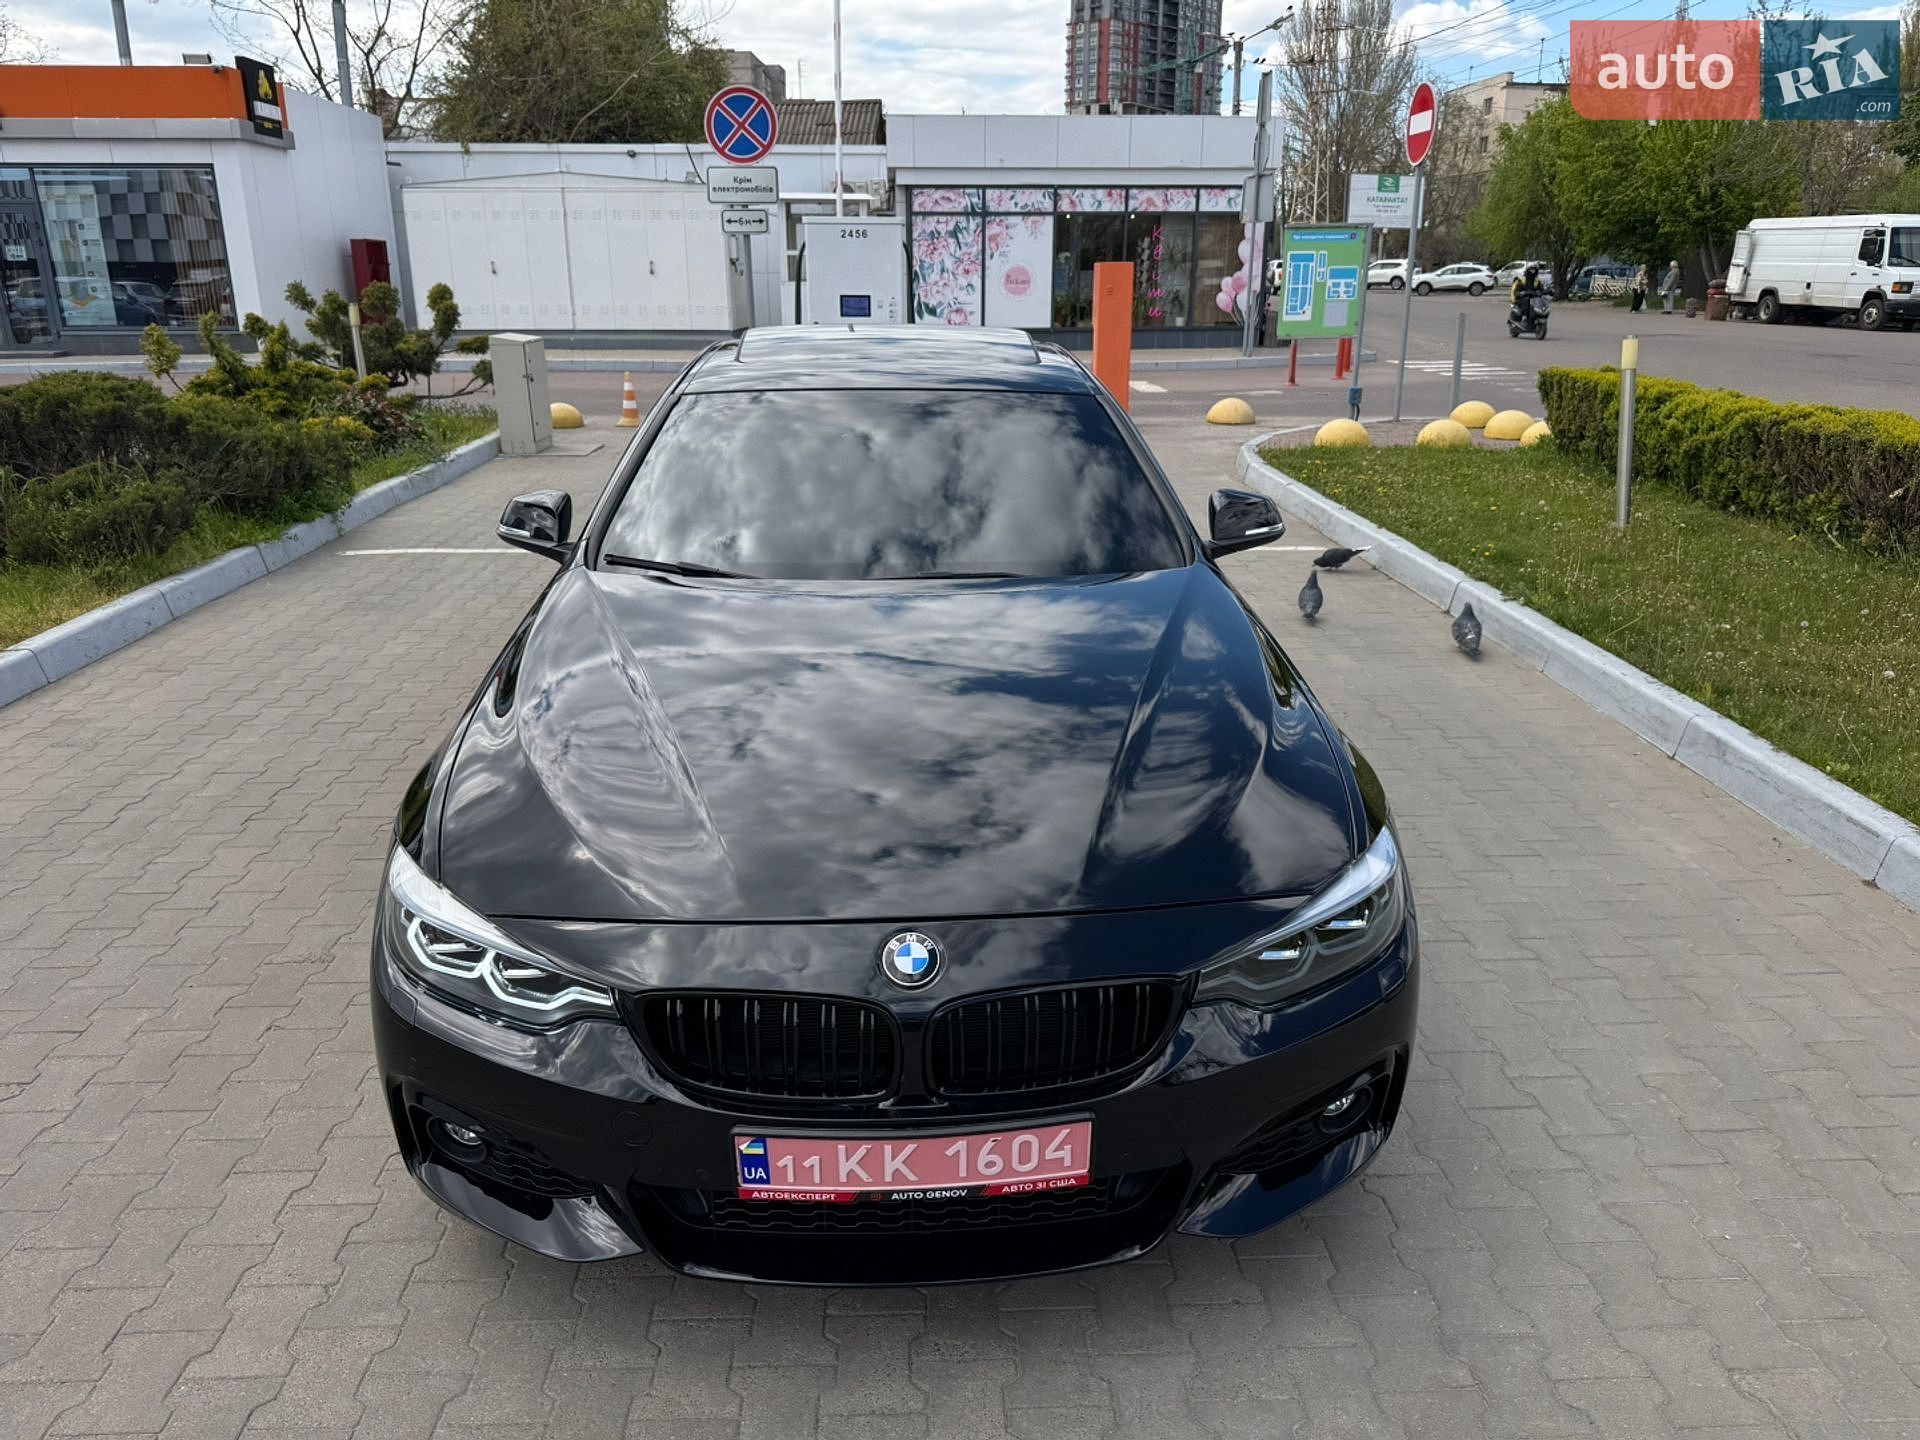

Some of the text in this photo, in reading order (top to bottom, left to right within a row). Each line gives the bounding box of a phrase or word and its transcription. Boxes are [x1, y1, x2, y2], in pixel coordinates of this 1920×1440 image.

[733, 175, 752, 185] Крім
[840, 229, 868, 239] 2456
[888, 934, 935, 951] BMW
[945, 1128, 1072, 1178] 1604
[743, 1167, 767, 1180] UA
[1002, 1184, 1033, 1194] АВТО
[1050, 1178, 1077, 1188] США
[751, 1190, 838, 1201] АВТОЕКСПЕРТ
[891, 1188, 968, 1201] AUTO GENOV
